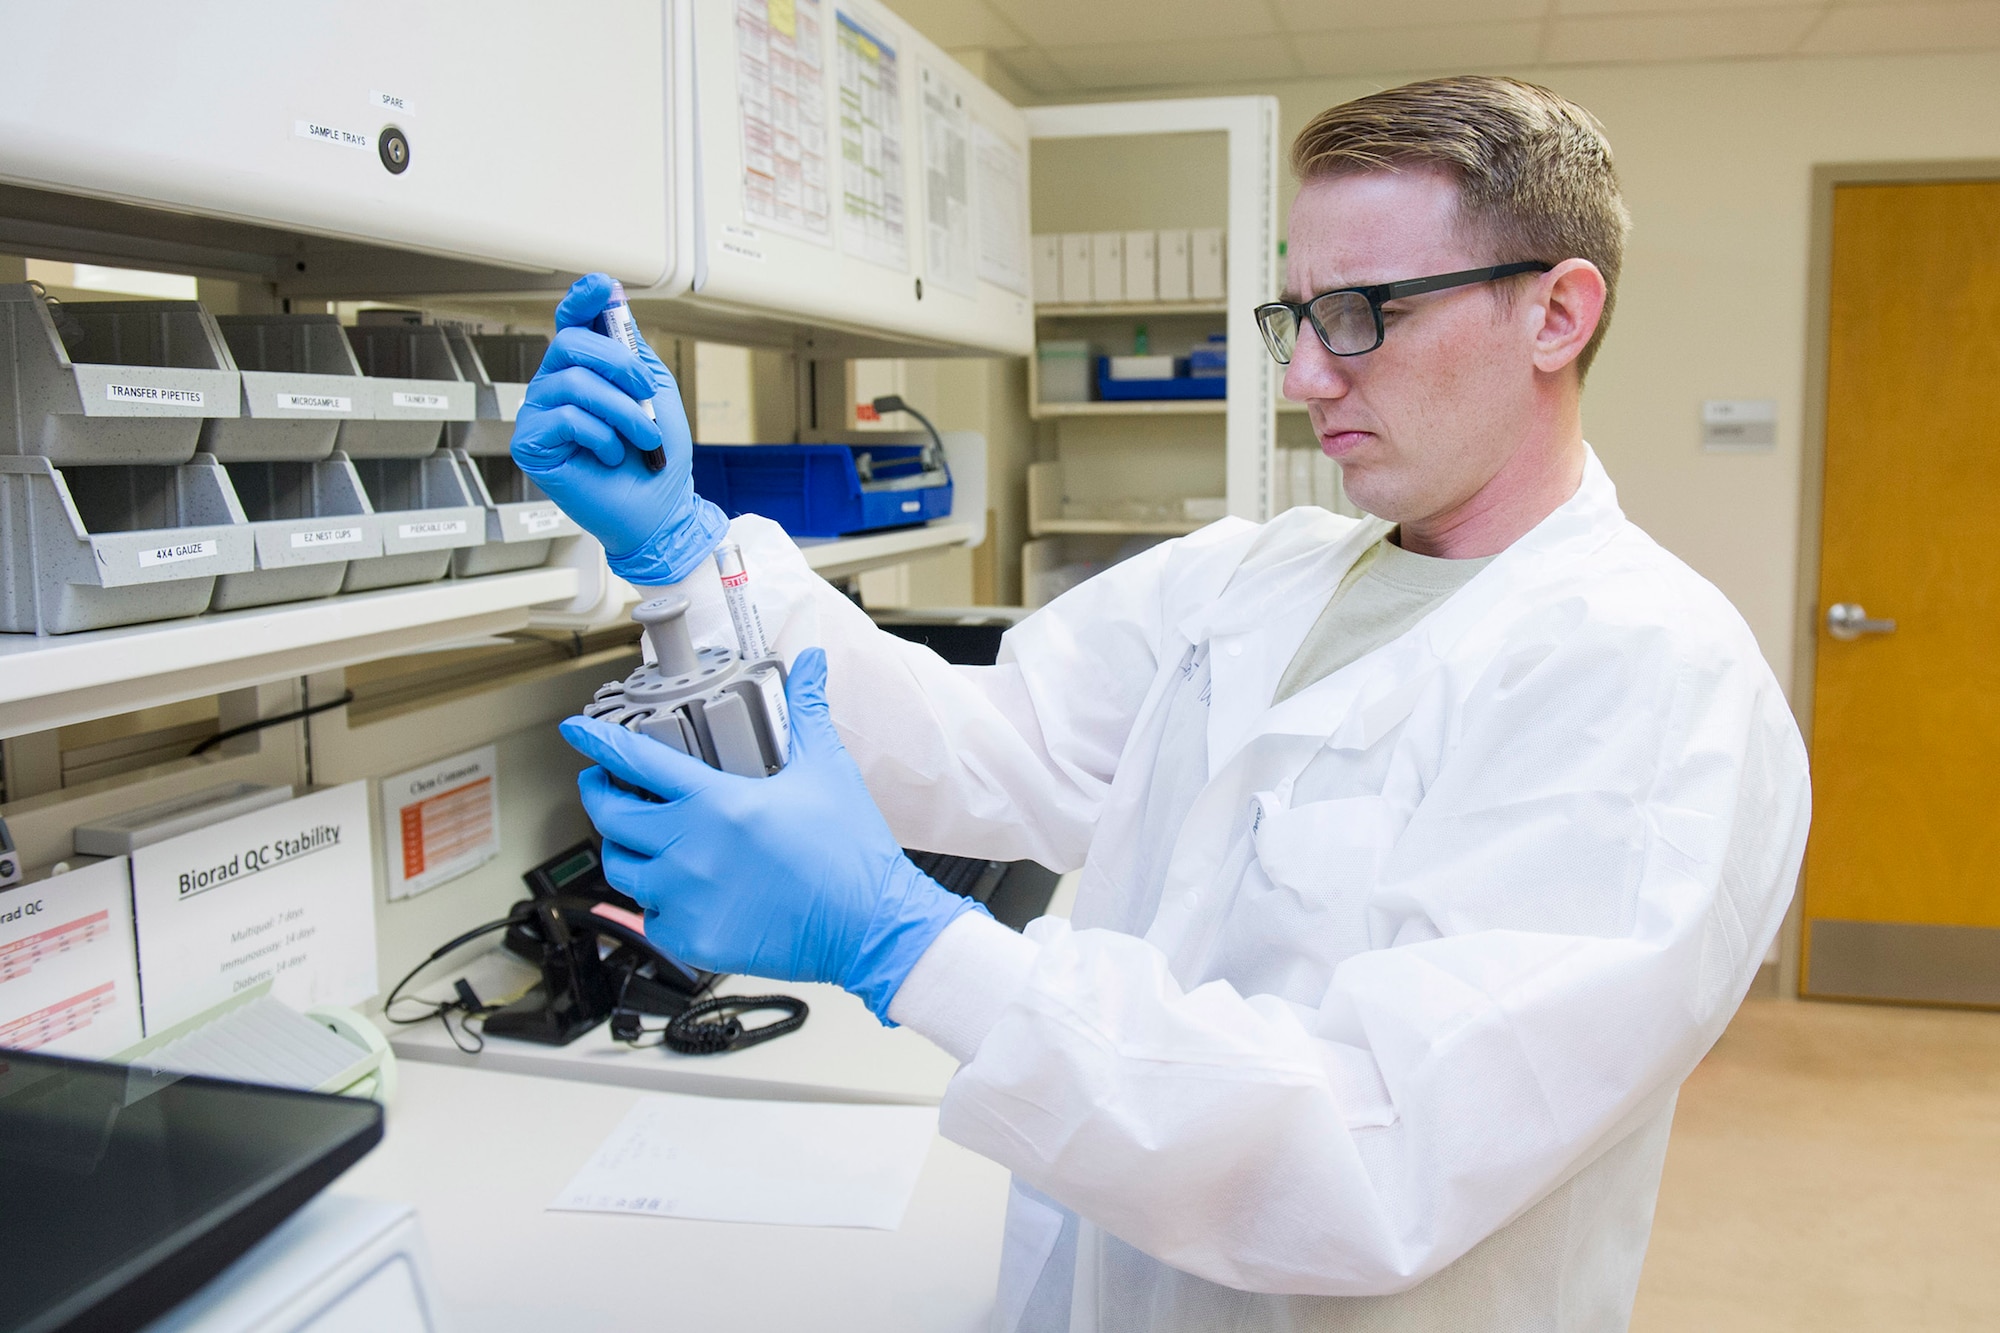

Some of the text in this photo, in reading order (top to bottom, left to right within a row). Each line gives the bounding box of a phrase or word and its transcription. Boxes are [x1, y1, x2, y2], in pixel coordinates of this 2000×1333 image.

[382, 94, 404, 109] SPARE
[309, 124, 366, 146] SAMPLE TRAYS
[112, 385, 201, 402] TRANSFER PIPETTES
[291, 396, 340, 408] MICROSAMPLE
[304, 529, 352, 542] EZ NEST CUPS
[156, 543, 203, 560] 4X4 GAUZE
[410, 763, 481, 796] Chem Comments
[178, 824, 342, 895] Biorad QC Stability
[25, 899, 44, 916] QC
[230, 916, 275, 945] Multiqual:
[284, 906, 305, 922] days
[285, 932, 296, 947] 14
[296, 925, 317, 943] days
[276, 962, 287, 974] 14
[287, 952, 308, 970] days
